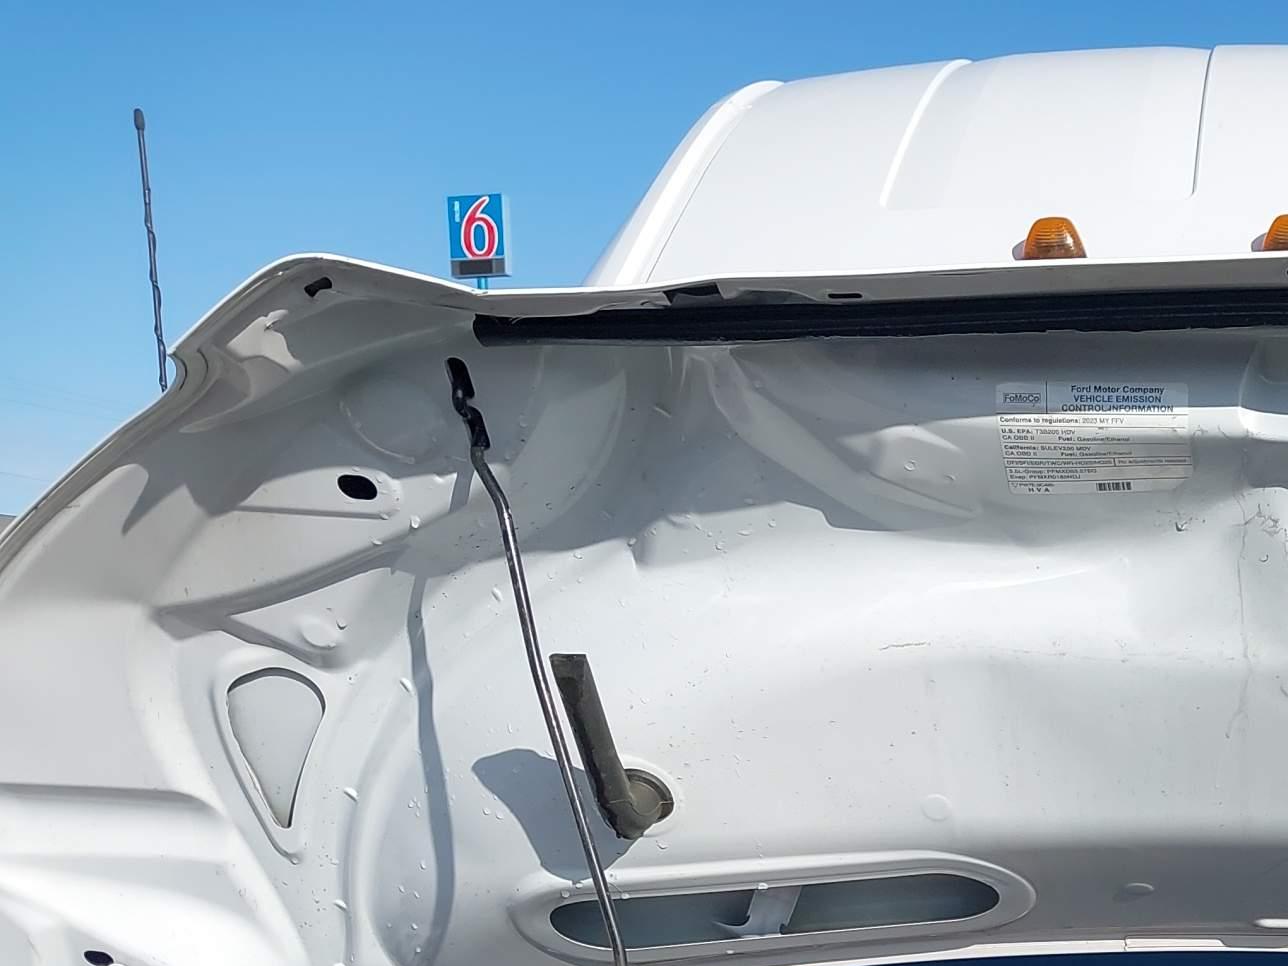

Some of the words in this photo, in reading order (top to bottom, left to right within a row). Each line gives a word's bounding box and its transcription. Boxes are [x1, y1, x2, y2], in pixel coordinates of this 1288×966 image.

[460, 195, 499, 259] 6
[1071, 385, 1092, 394] Ford
[1094, 385, 1120, 394] Motor
[1122, 386, 1164, 396] Company
[1004, 394, 1040, 404] FoMoCo
[1073, 395, 1113, 403] VEHICLE
[1062, 404, 1106, 412] CONTROL
[1109, 404, 1173, 412] INFORMATION
